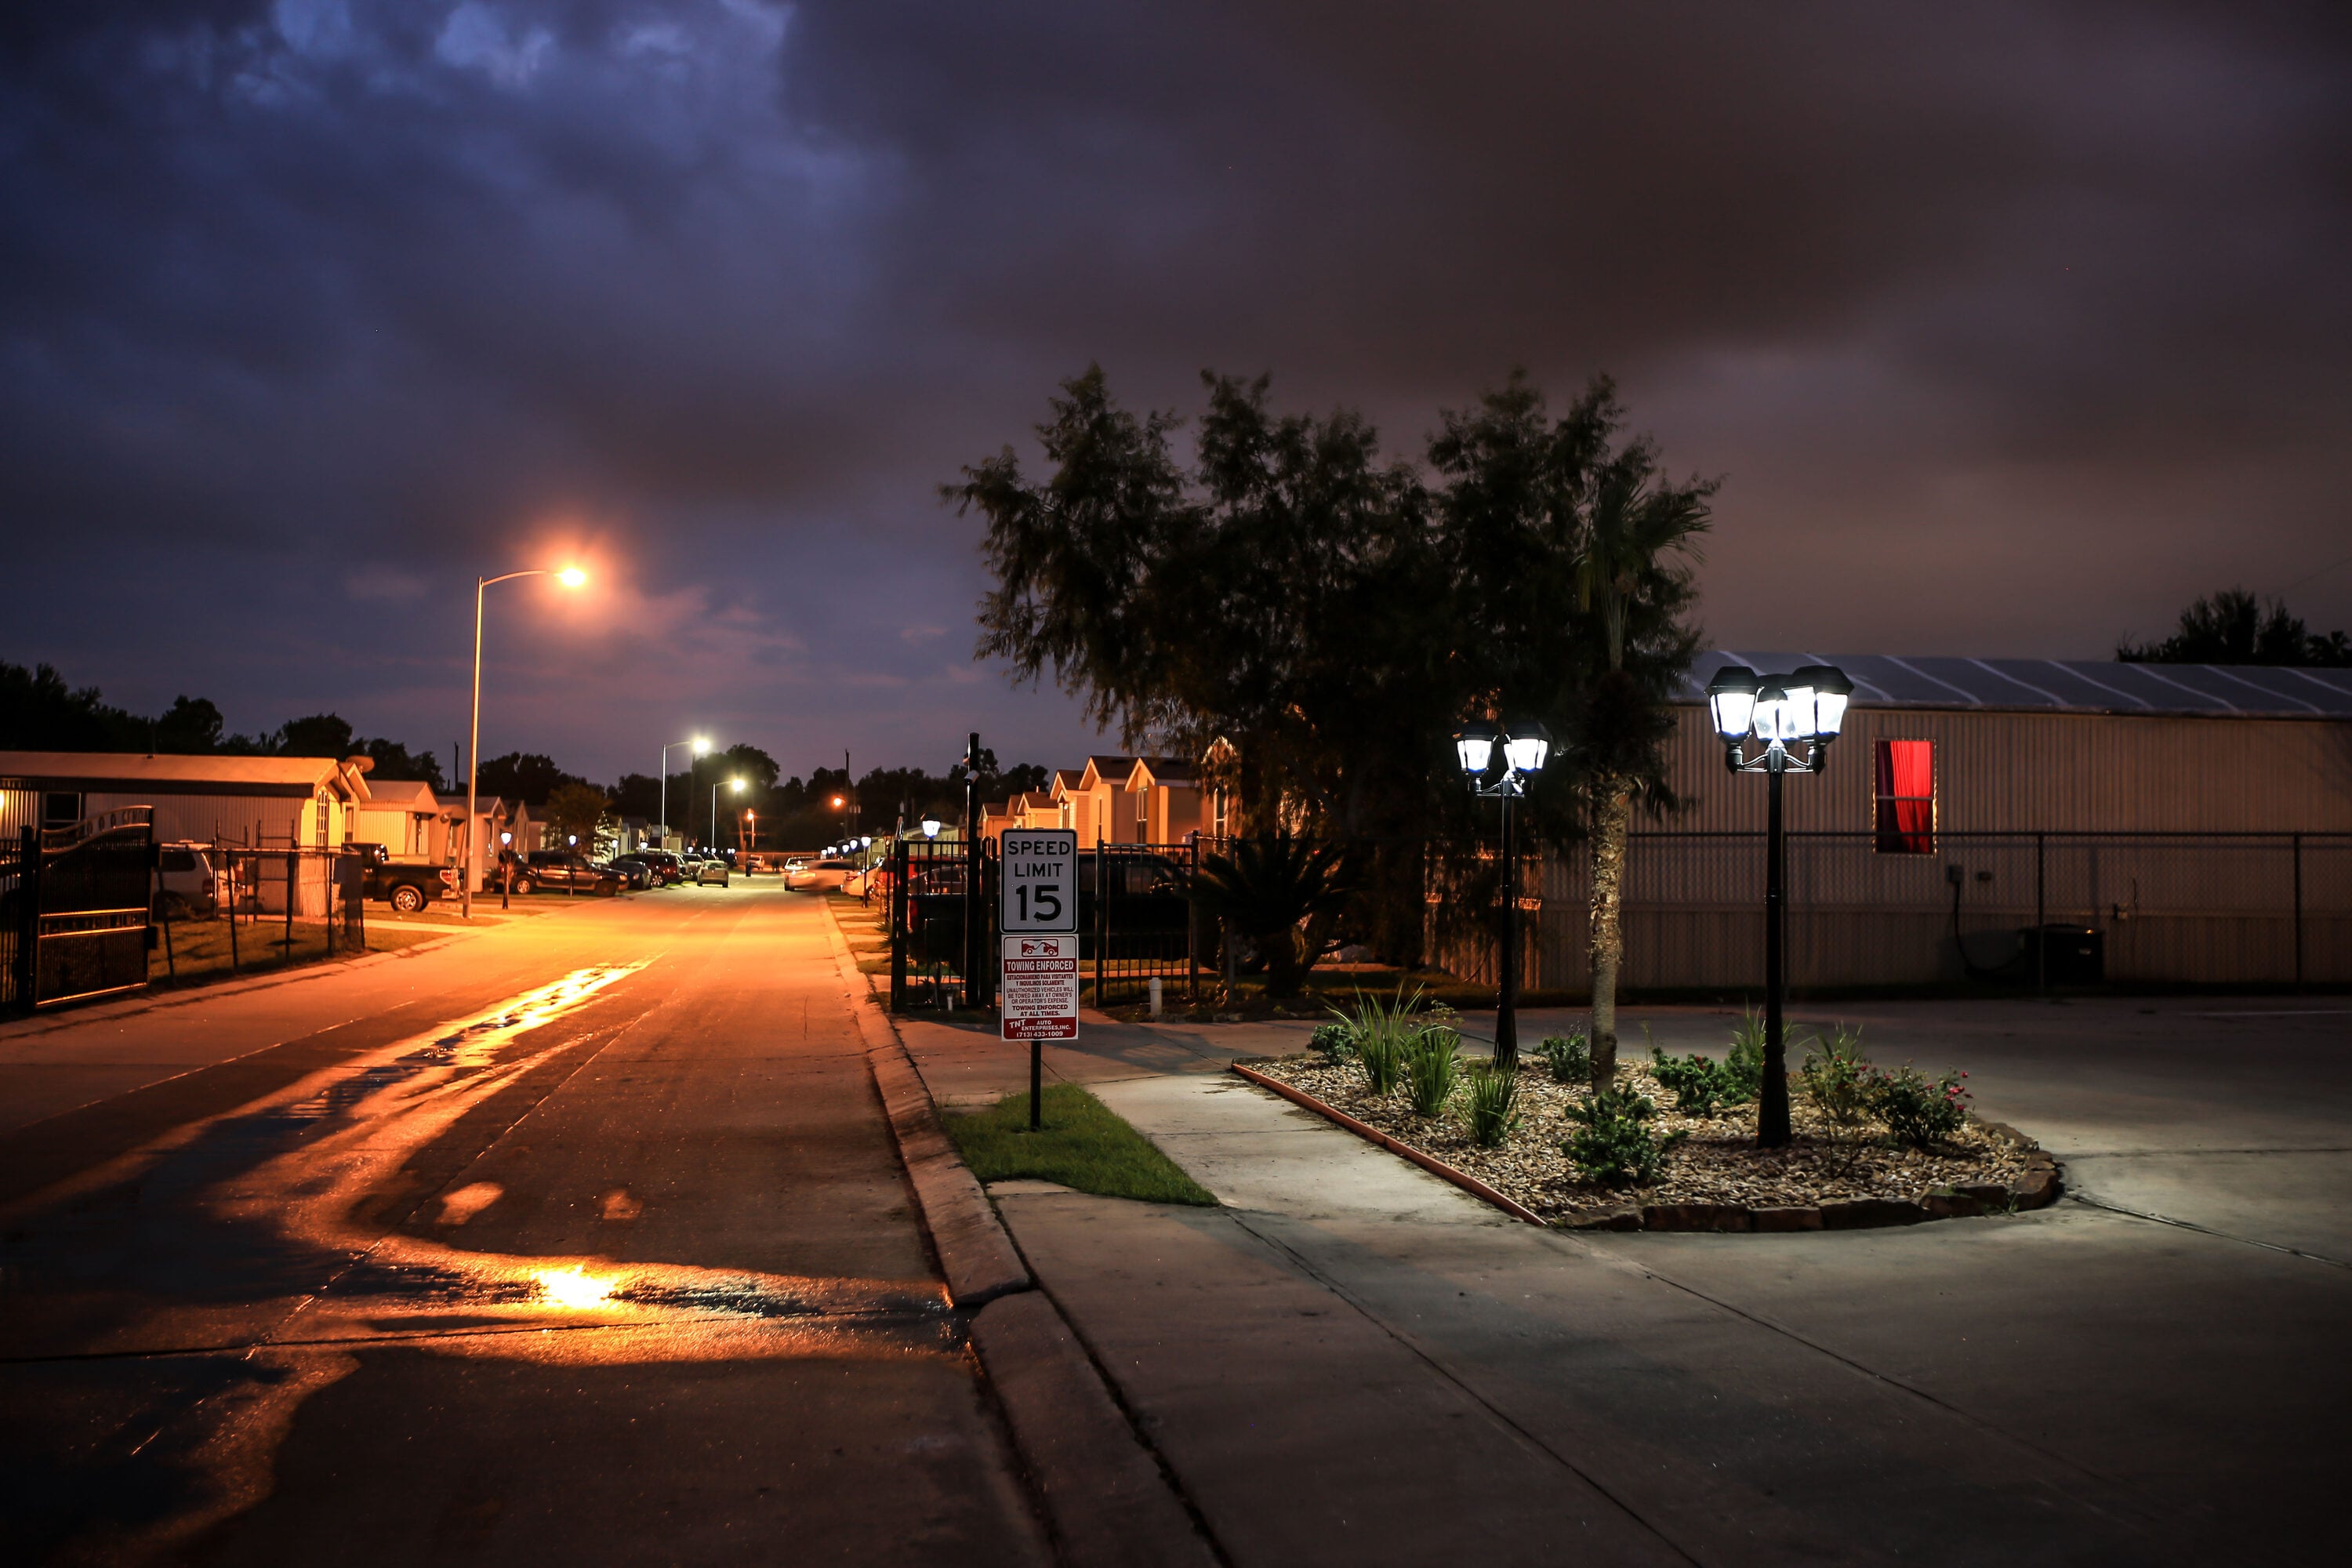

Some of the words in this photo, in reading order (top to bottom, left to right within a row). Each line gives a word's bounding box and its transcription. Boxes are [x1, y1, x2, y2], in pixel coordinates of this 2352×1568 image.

[1008, 841, 1070, 855] SPEED
[1014, 863, 1063, 877] LIMIT
[1016, 884, 1062, 921] 15
[1007, 961, 1034, 971] TOWING
[1036, 960, 1073, 971] ENFORCED
[1009, 1019, 1026, 1029] TNT
